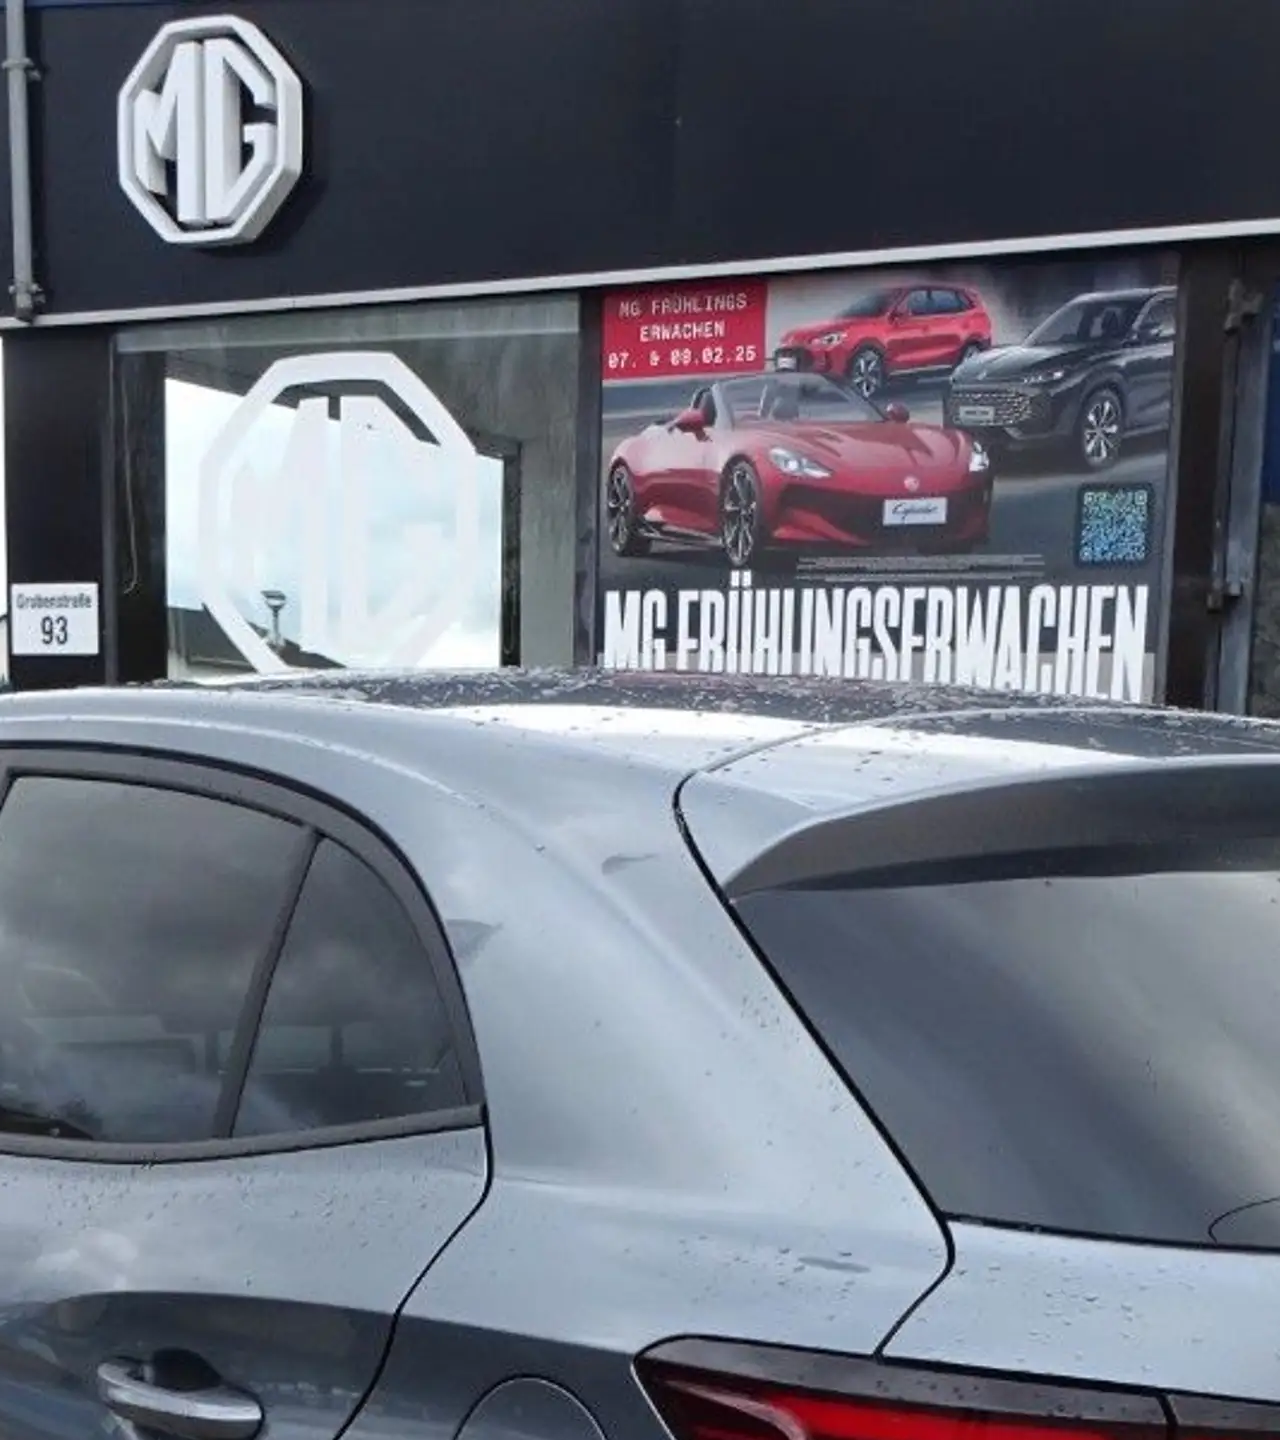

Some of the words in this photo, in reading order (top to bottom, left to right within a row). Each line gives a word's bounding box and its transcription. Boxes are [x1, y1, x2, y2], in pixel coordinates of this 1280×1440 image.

[134, 37, 277, 225] MG
[639, 321, 726, 342] ERWACHEN
[40, 615, 69, 645] 93
[604, 587, 668, 671] MG
[675, 569, 1150, 704] FRÜHLINGSERWACHEN
